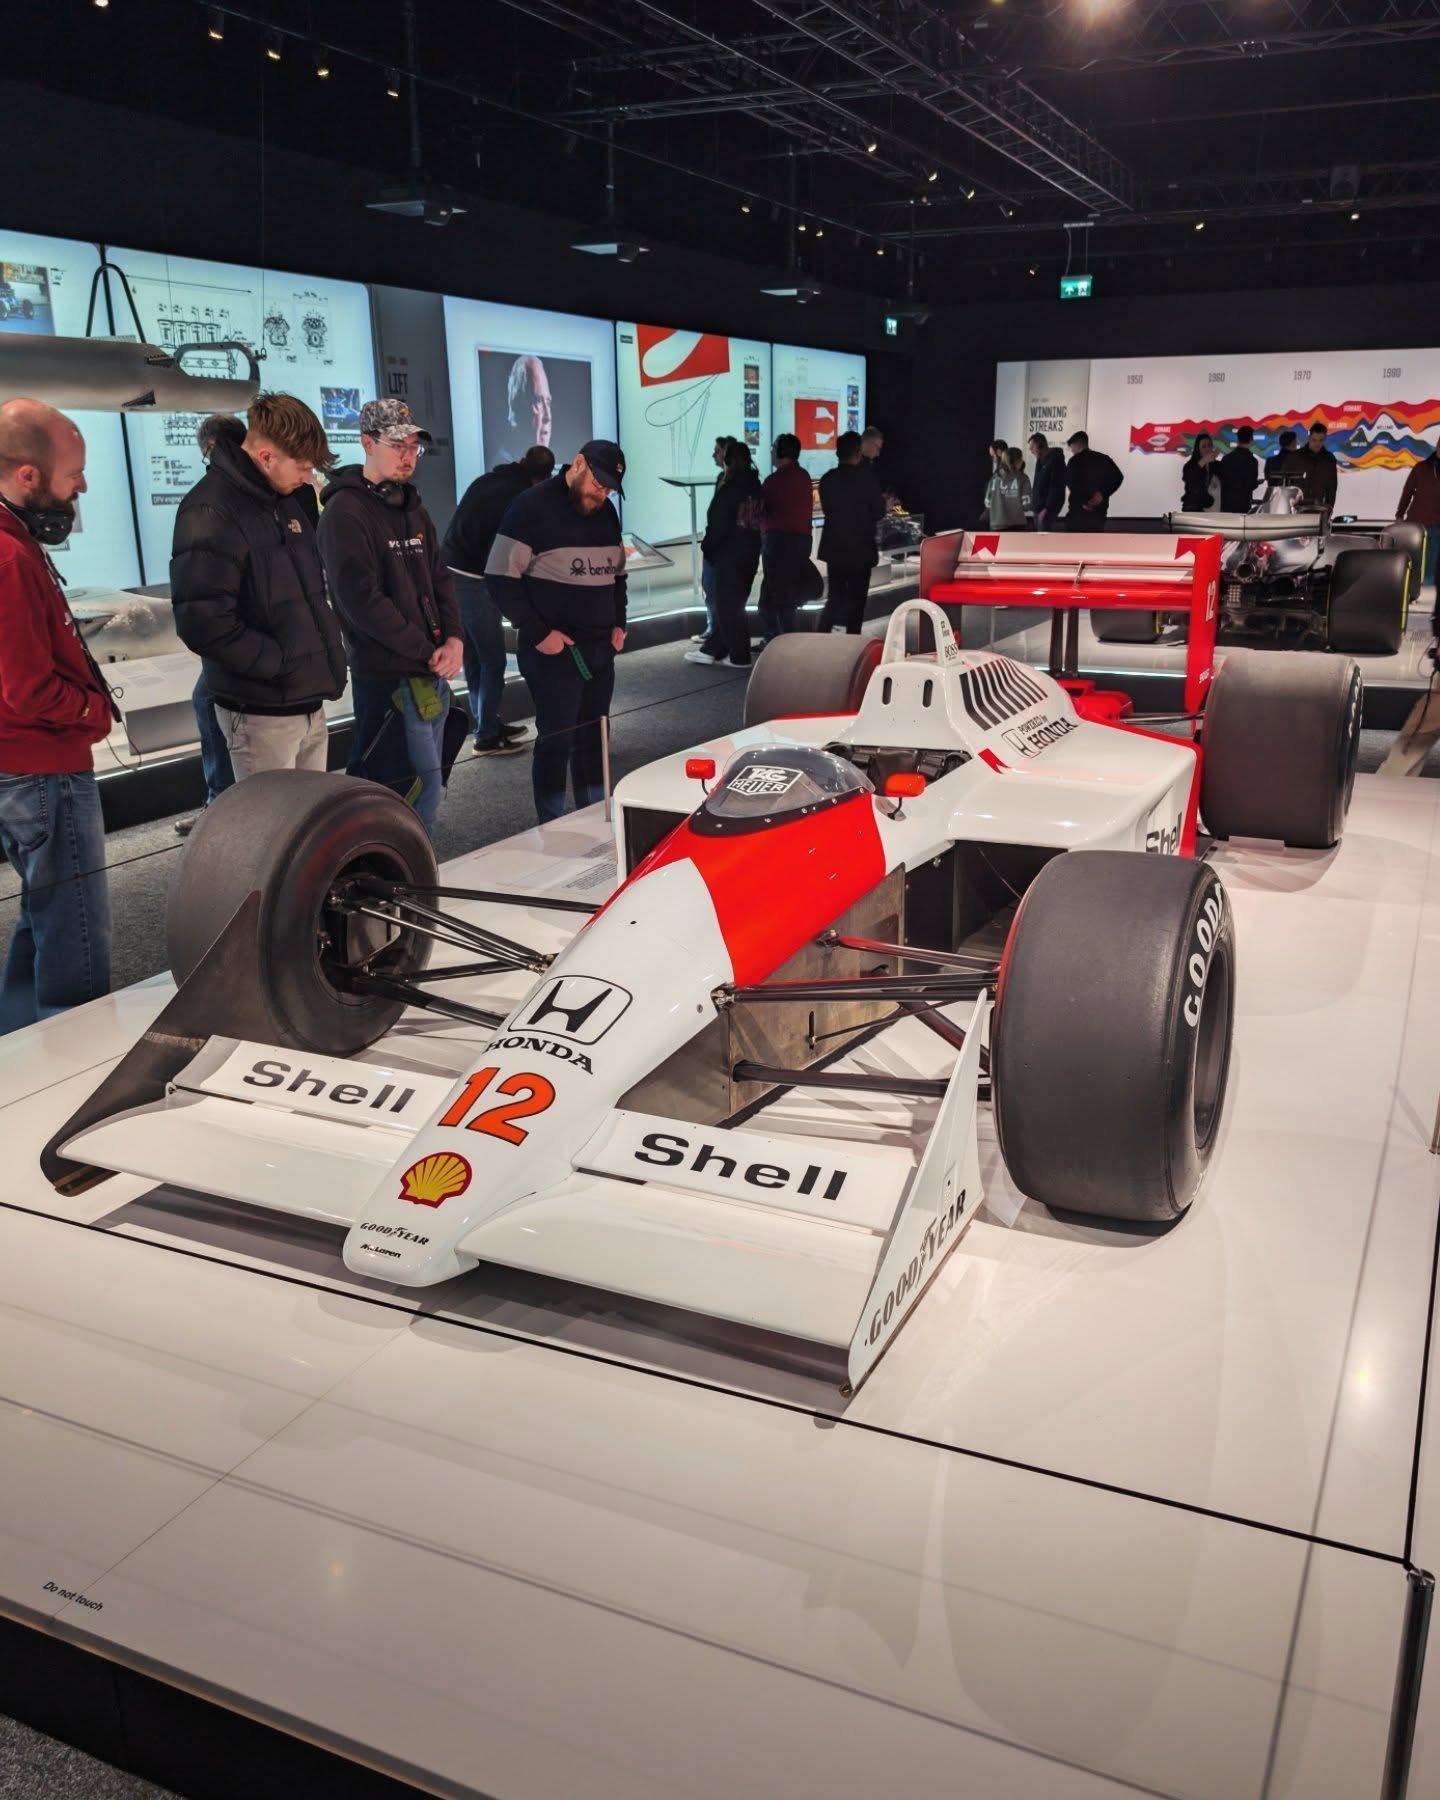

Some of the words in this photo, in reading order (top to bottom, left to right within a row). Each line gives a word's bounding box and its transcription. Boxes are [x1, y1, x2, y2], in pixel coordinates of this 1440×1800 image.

[388, 372, 408, 394] LIFT
[1293, 370, 1312, 380] 1970
[1030, 406, 1067, 418] WINNING
[1029, 420, 1063, 432] STREAKS
[944, 643, 958, 659] BOSS
[1027, 717, 1079, 750] HONDA
[748, 768, 788, 781] TAG
[732, 780, 783, 793] HEUER
[481, 1036, 594, 1076] HONDA
[242, 1060, 417, 1114] Shell
[437, 1066, 557, 1147] 12
[634, 1132, 848, 1201] Shell
[43, 1581, 59, 1592] Do
[58, 1589, 77, 1600] not
[75, 1595, 103, 1611] touch
